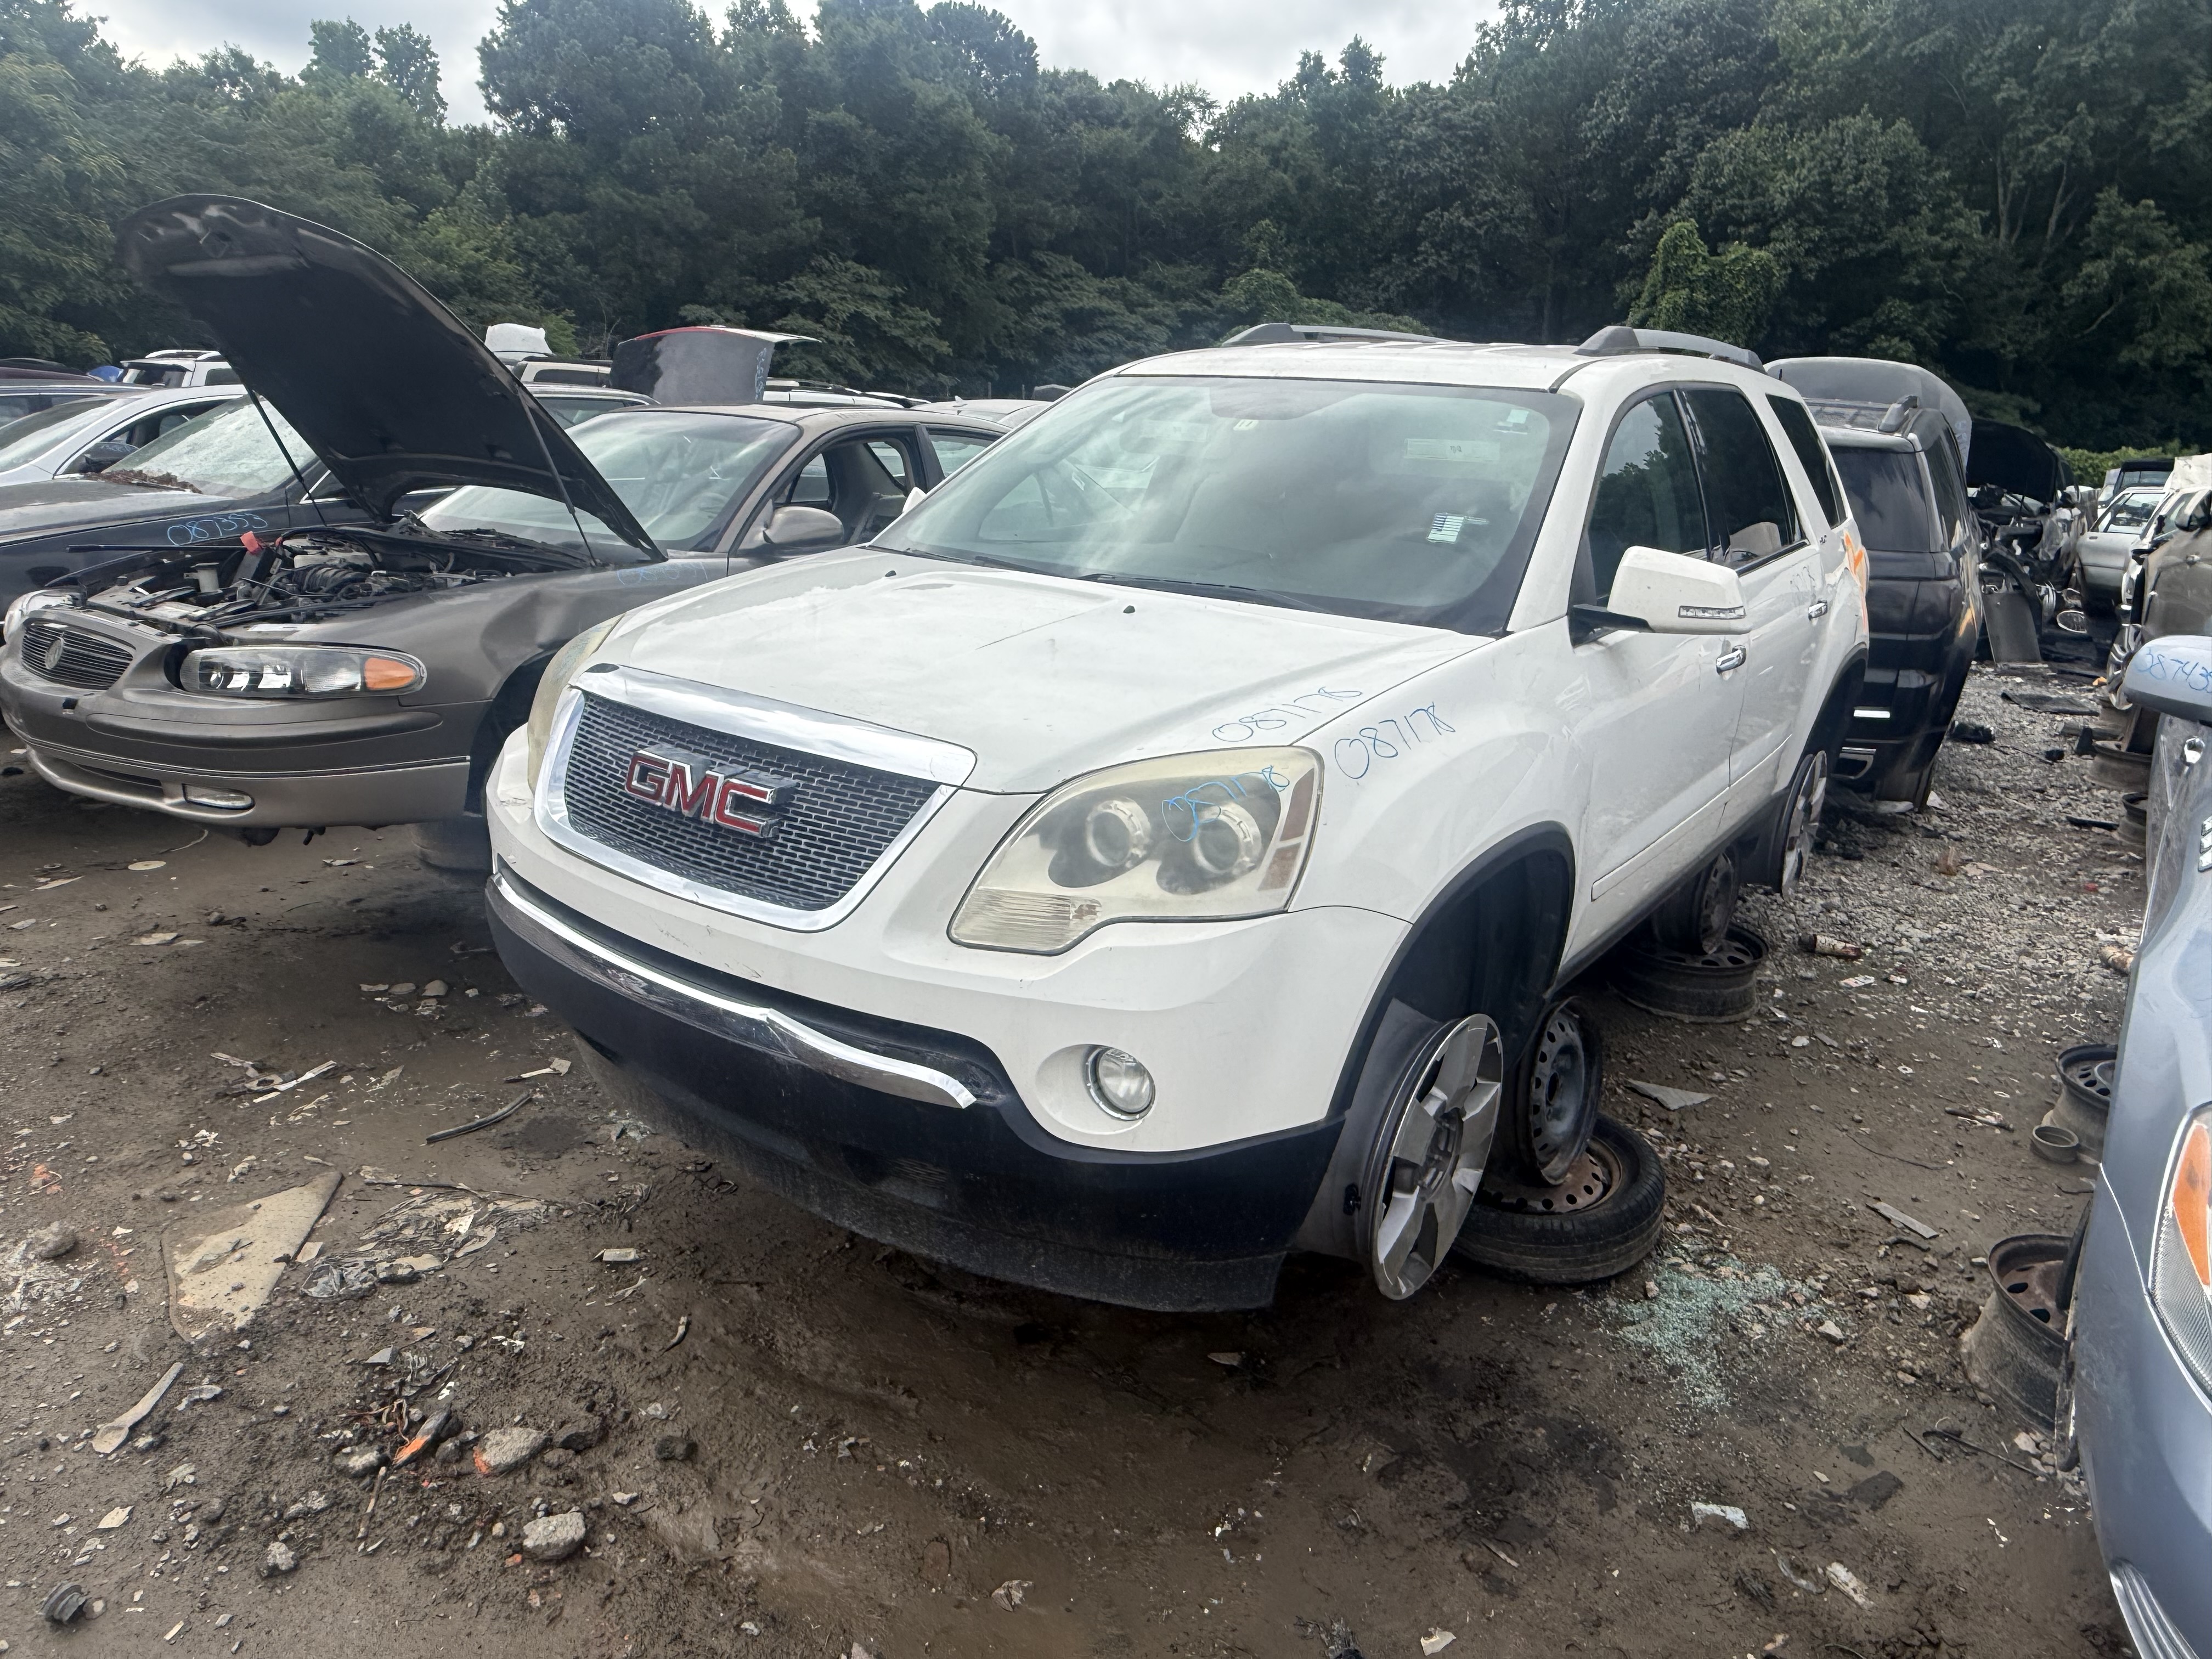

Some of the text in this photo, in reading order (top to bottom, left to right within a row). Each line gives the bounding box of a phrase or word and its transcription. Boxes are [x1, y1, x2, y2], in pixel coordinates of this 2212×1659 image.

[167, 514, 269, 546] 087353
[1212, 686, 1363, 742] 087178
[1334, 701, 1457, 780] 087178
[624, 749, 778, 839] GMC
